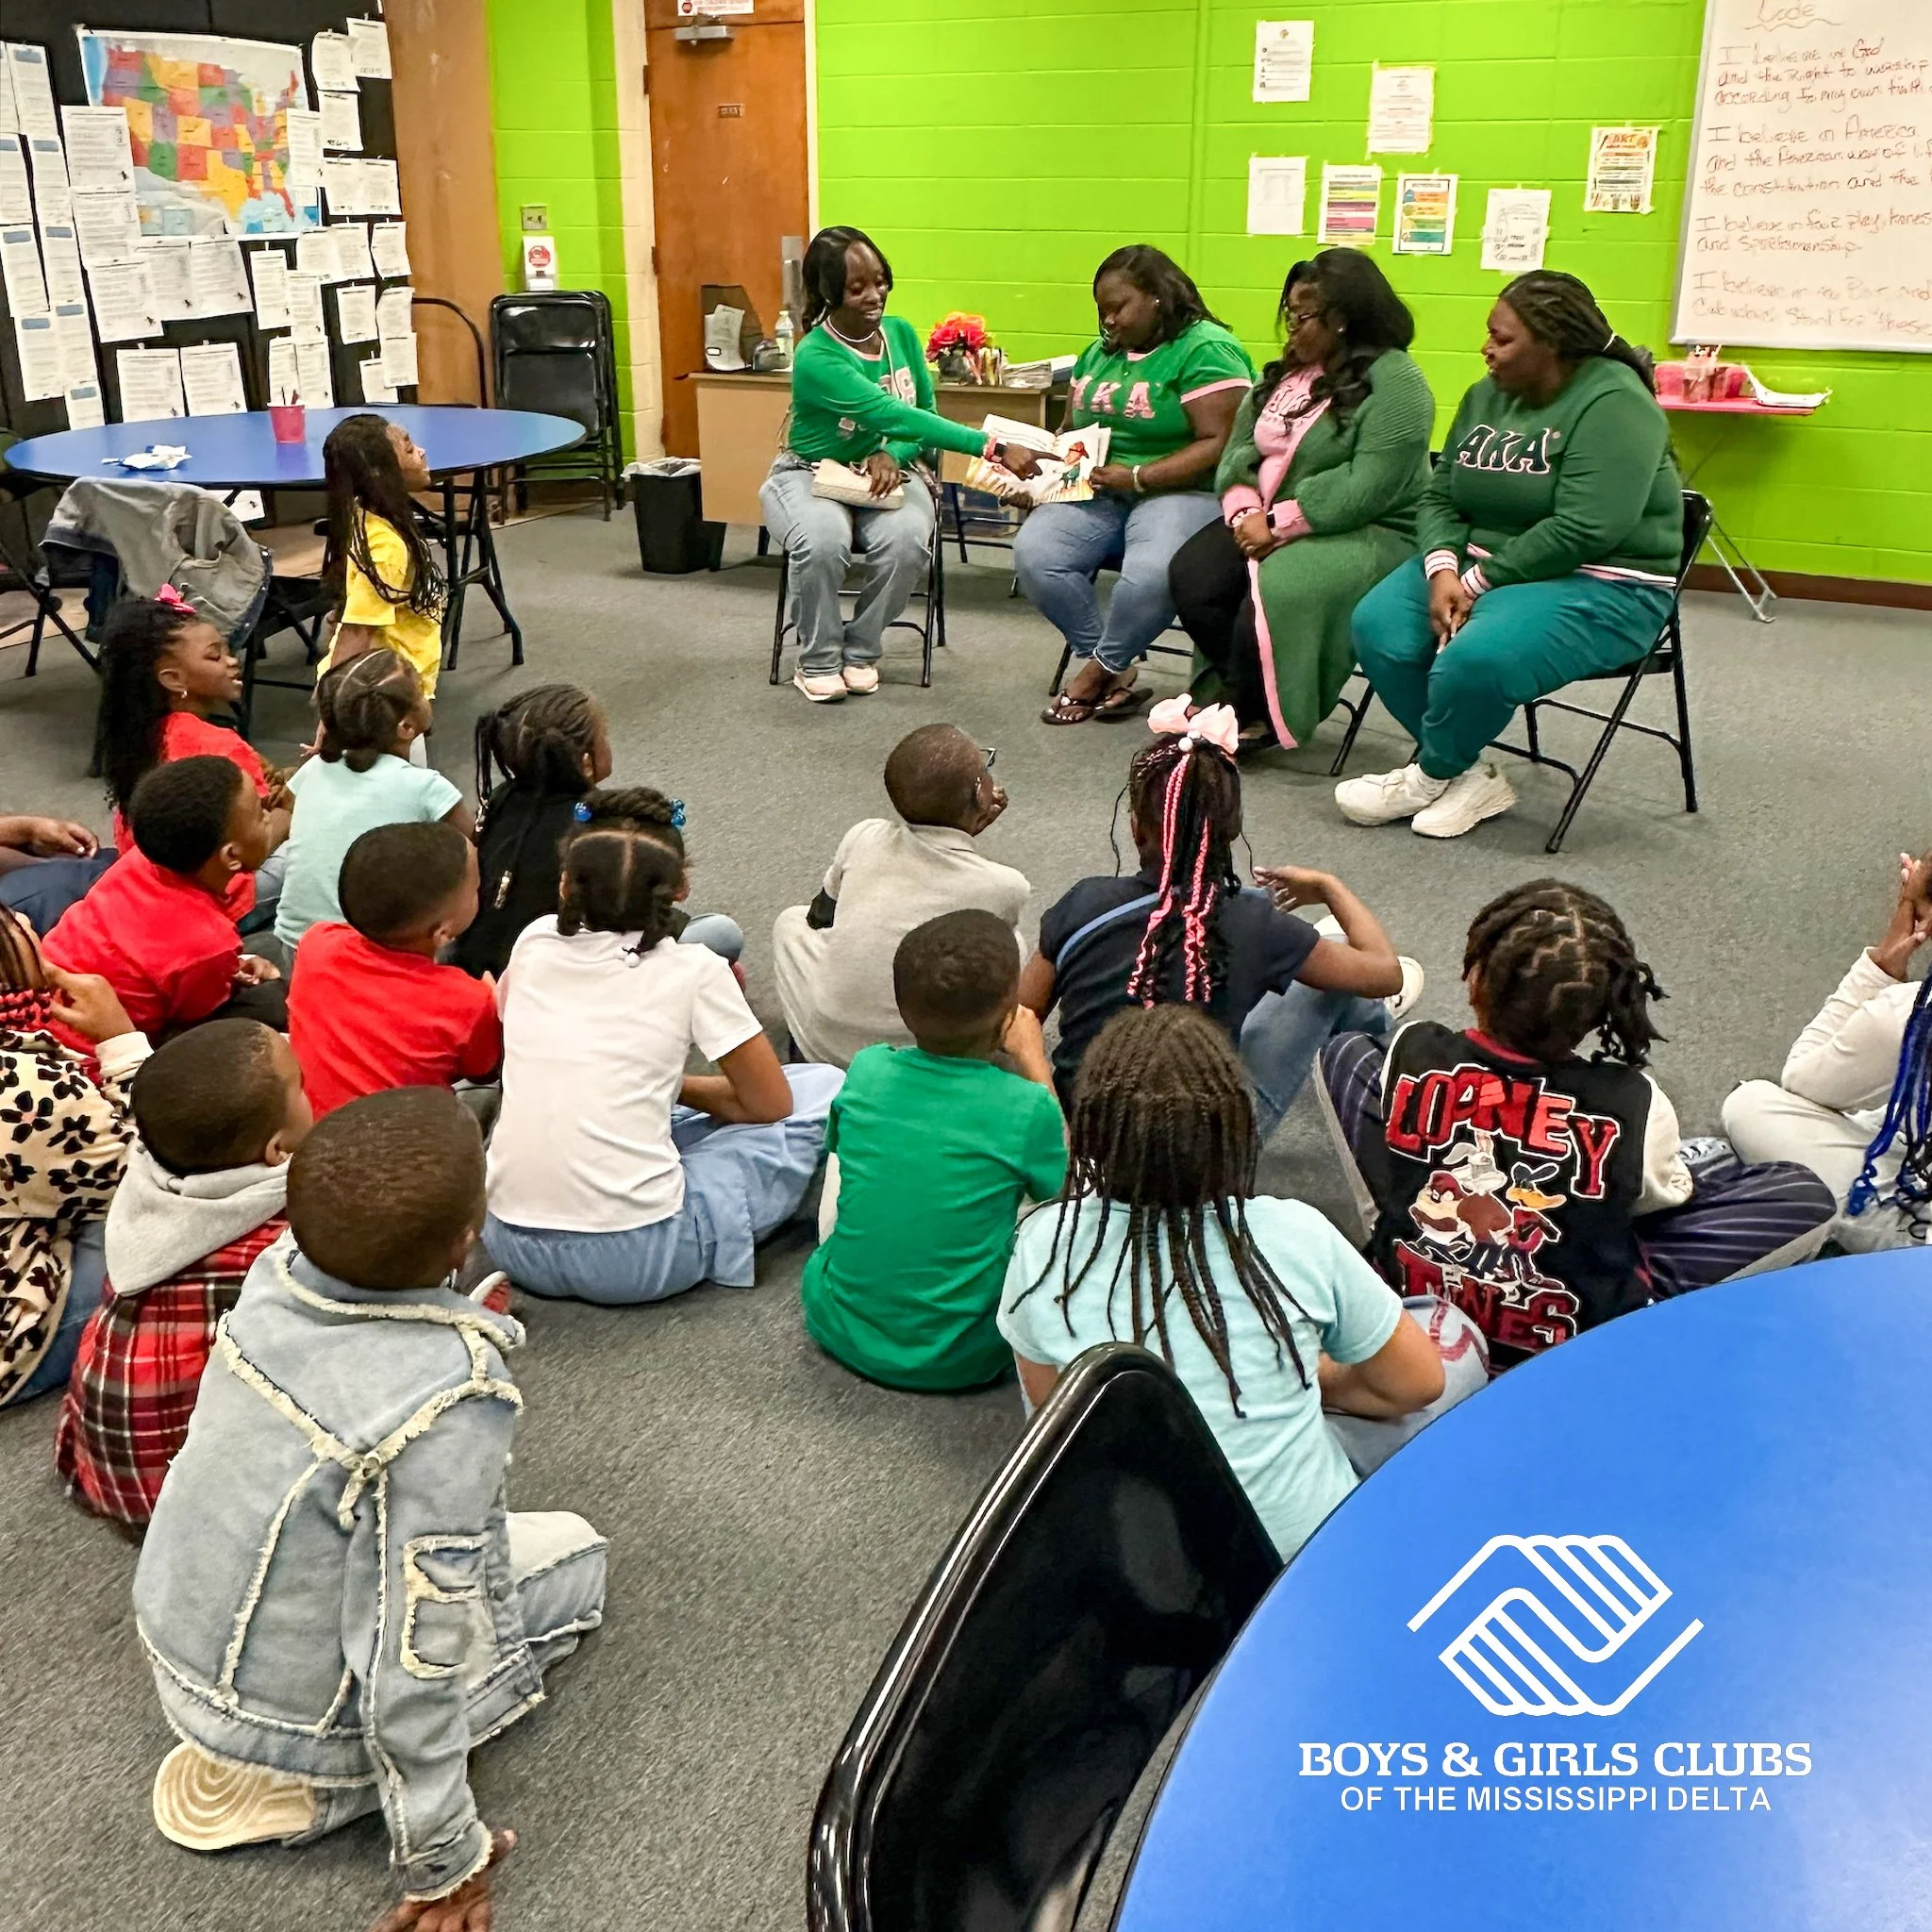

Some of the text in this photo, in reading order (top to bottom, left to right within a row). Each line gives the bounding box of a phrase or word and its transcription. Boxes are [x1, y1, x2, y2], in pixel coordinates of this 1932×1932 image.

[1718, 45, 1751, 65] I
[1707, 125, 1732, 142] I
[1696, 215, 1721, 232] I
[1456, 424, 1553, 475] AKA
[1391, 1237, 1581, 1355] TNES
